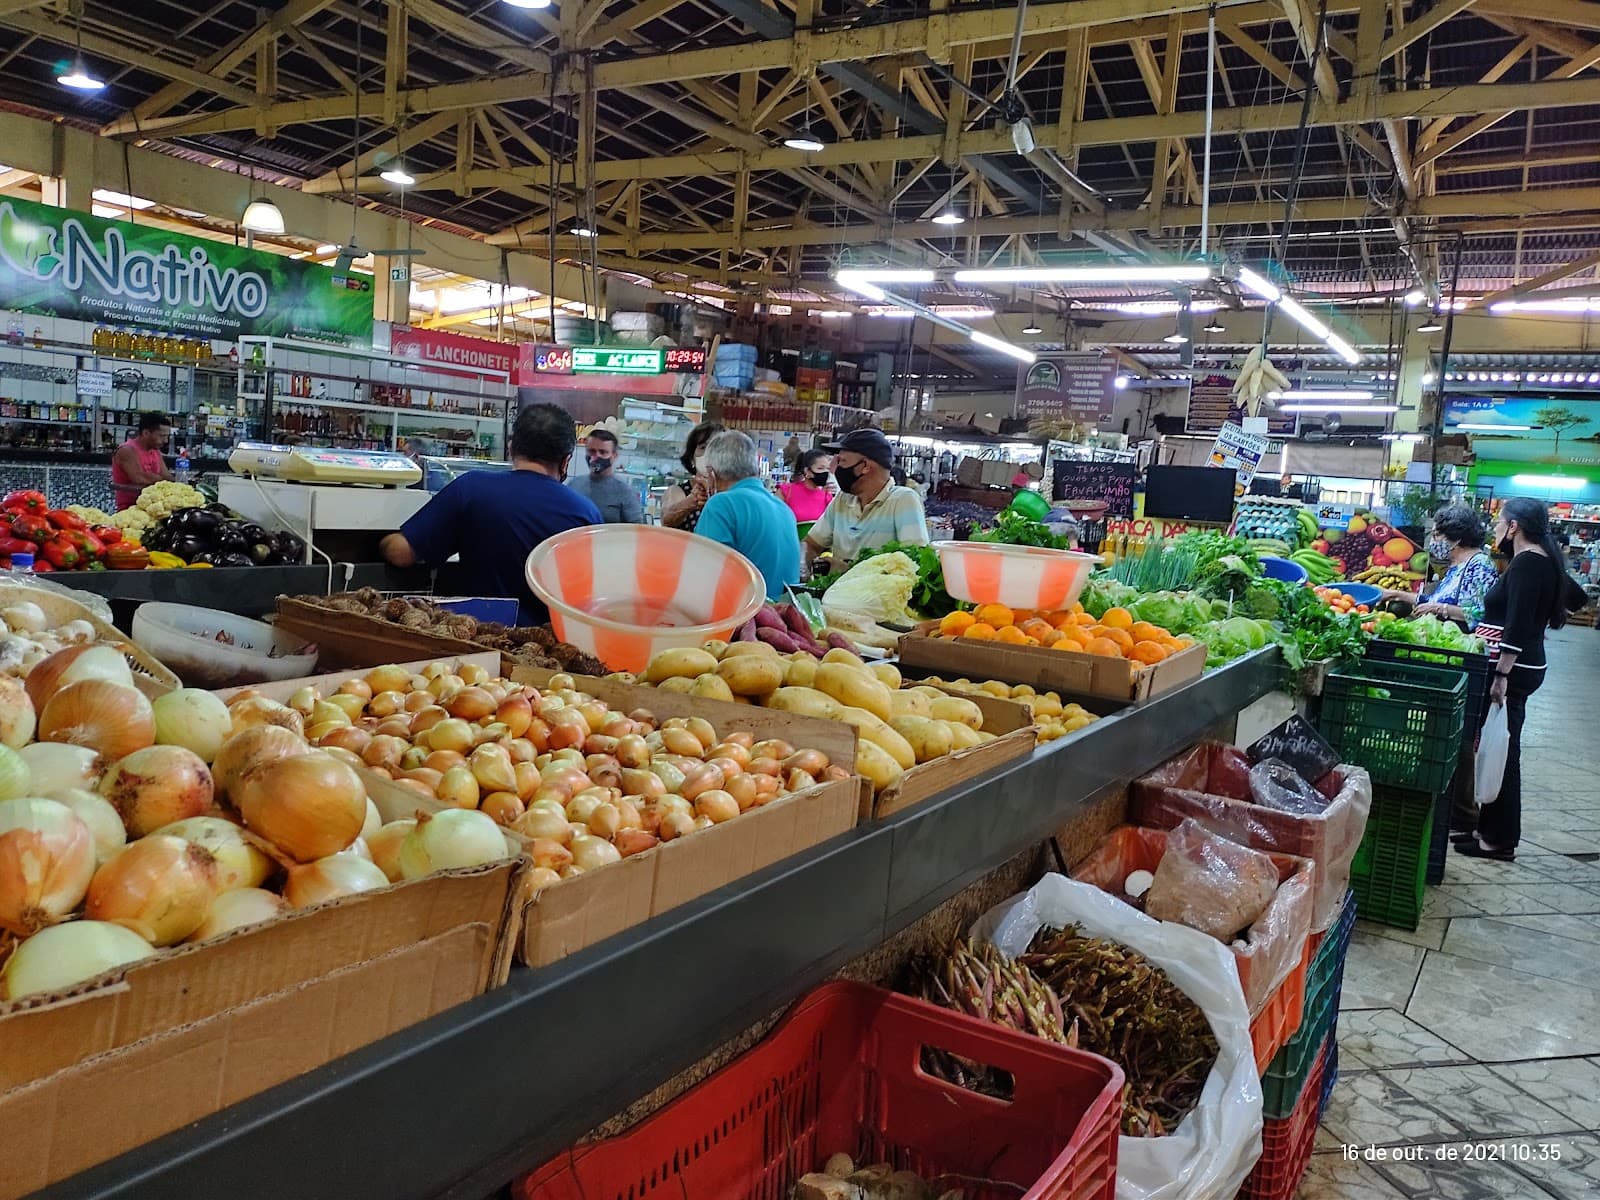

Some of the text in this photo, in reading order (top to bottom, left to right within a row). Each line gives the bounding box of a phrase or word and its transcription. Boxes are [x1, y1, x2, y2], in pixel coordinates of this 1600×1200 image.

[63, 219, 268, 317] Nativo
[80, 295, 123, 310] Produtos
[125, 302, 163, 316] Naturais
[197, 313, 240, 327] Medicinais
[104, 310, 133, 321] Procure
[425, 343, 510, 370] LANCHONETE
[547, 351, 571, 369] Café
[666, 350, 704, 364] 10:29:54
[1223, 422, 1251, 438] ACEITAOS
[1224, 431, 1261, 453] OS CARTÕES
[1075, 465, 1114, 473] TEMOS
[1107, 519, 1155, 537] ANCA
